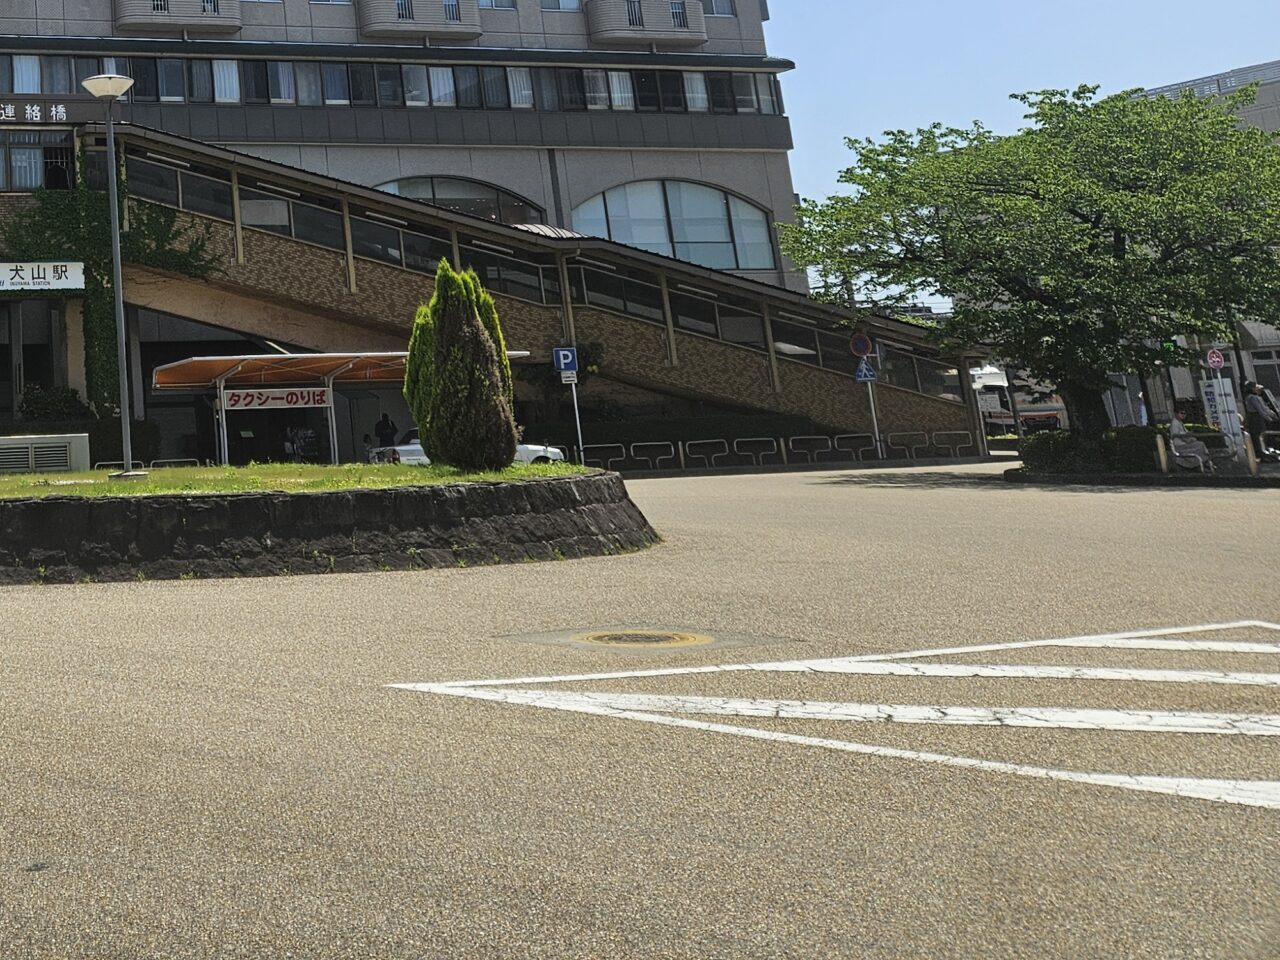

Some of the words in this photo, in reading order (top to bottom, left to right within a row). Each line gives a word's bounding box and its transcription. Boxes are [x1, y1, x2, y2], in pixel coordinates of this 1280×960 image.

[9, 264, 69, 280] 犬山駅
[559, 350, 573, 369] P
[228, 389, 327, 407] タクシーのりば
